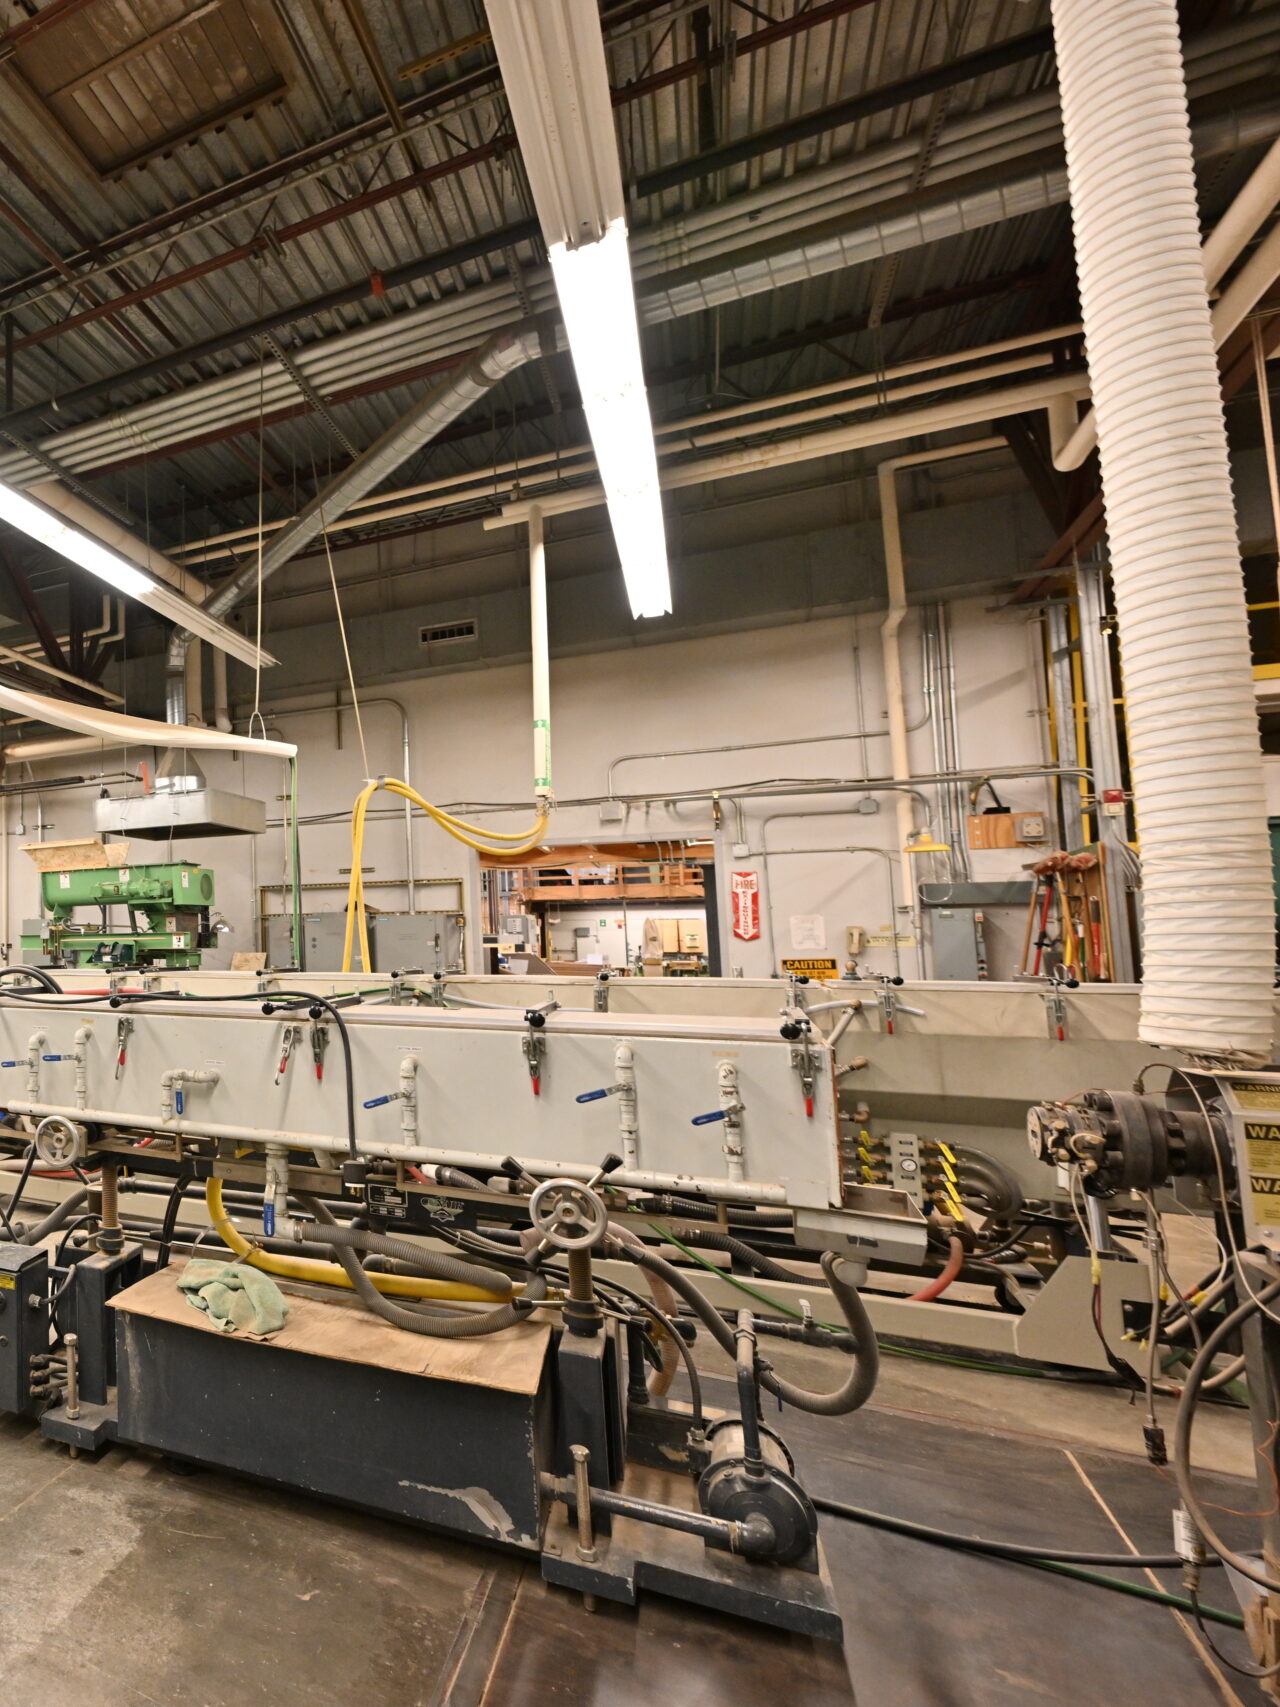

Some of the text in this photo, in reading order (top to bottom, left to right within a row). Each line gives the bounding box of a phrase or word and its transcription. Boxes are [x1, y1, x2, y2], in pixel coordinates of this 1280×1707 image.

[735, 879, 755, 889] FIRE
[786, 960, 832, 969] CAUTION
[1233, 1084, 1280, 1092] WARNI
